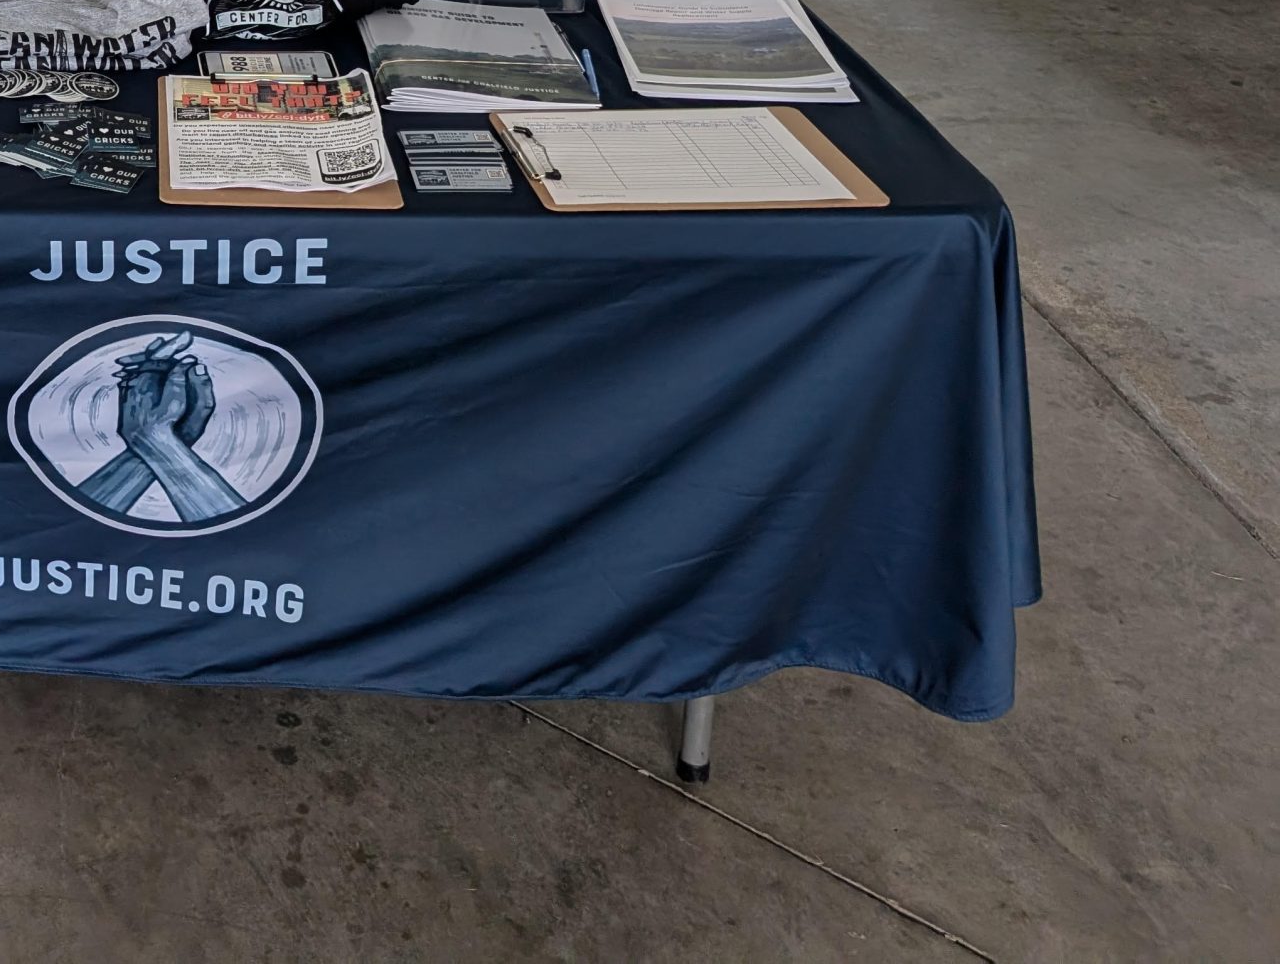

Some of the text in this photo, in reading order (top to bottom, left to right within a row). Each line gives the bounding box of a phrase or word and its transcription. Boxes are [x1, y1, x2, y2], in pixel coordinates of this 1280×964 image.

[230, 12, 308, 24] CENTER FOR
[72, 16, 177, 57] WATER
[231, 56, 248, 72] 988
[182, 90, 362, 108] FEEL THAT?
[235, 112, 326, 122] bit.ly/ccj-dyft
[36, 140, 74, 157] CRICKS
[62, 140, 82, 150] OUR
[30, 238, 328, 284] JUSTICE
